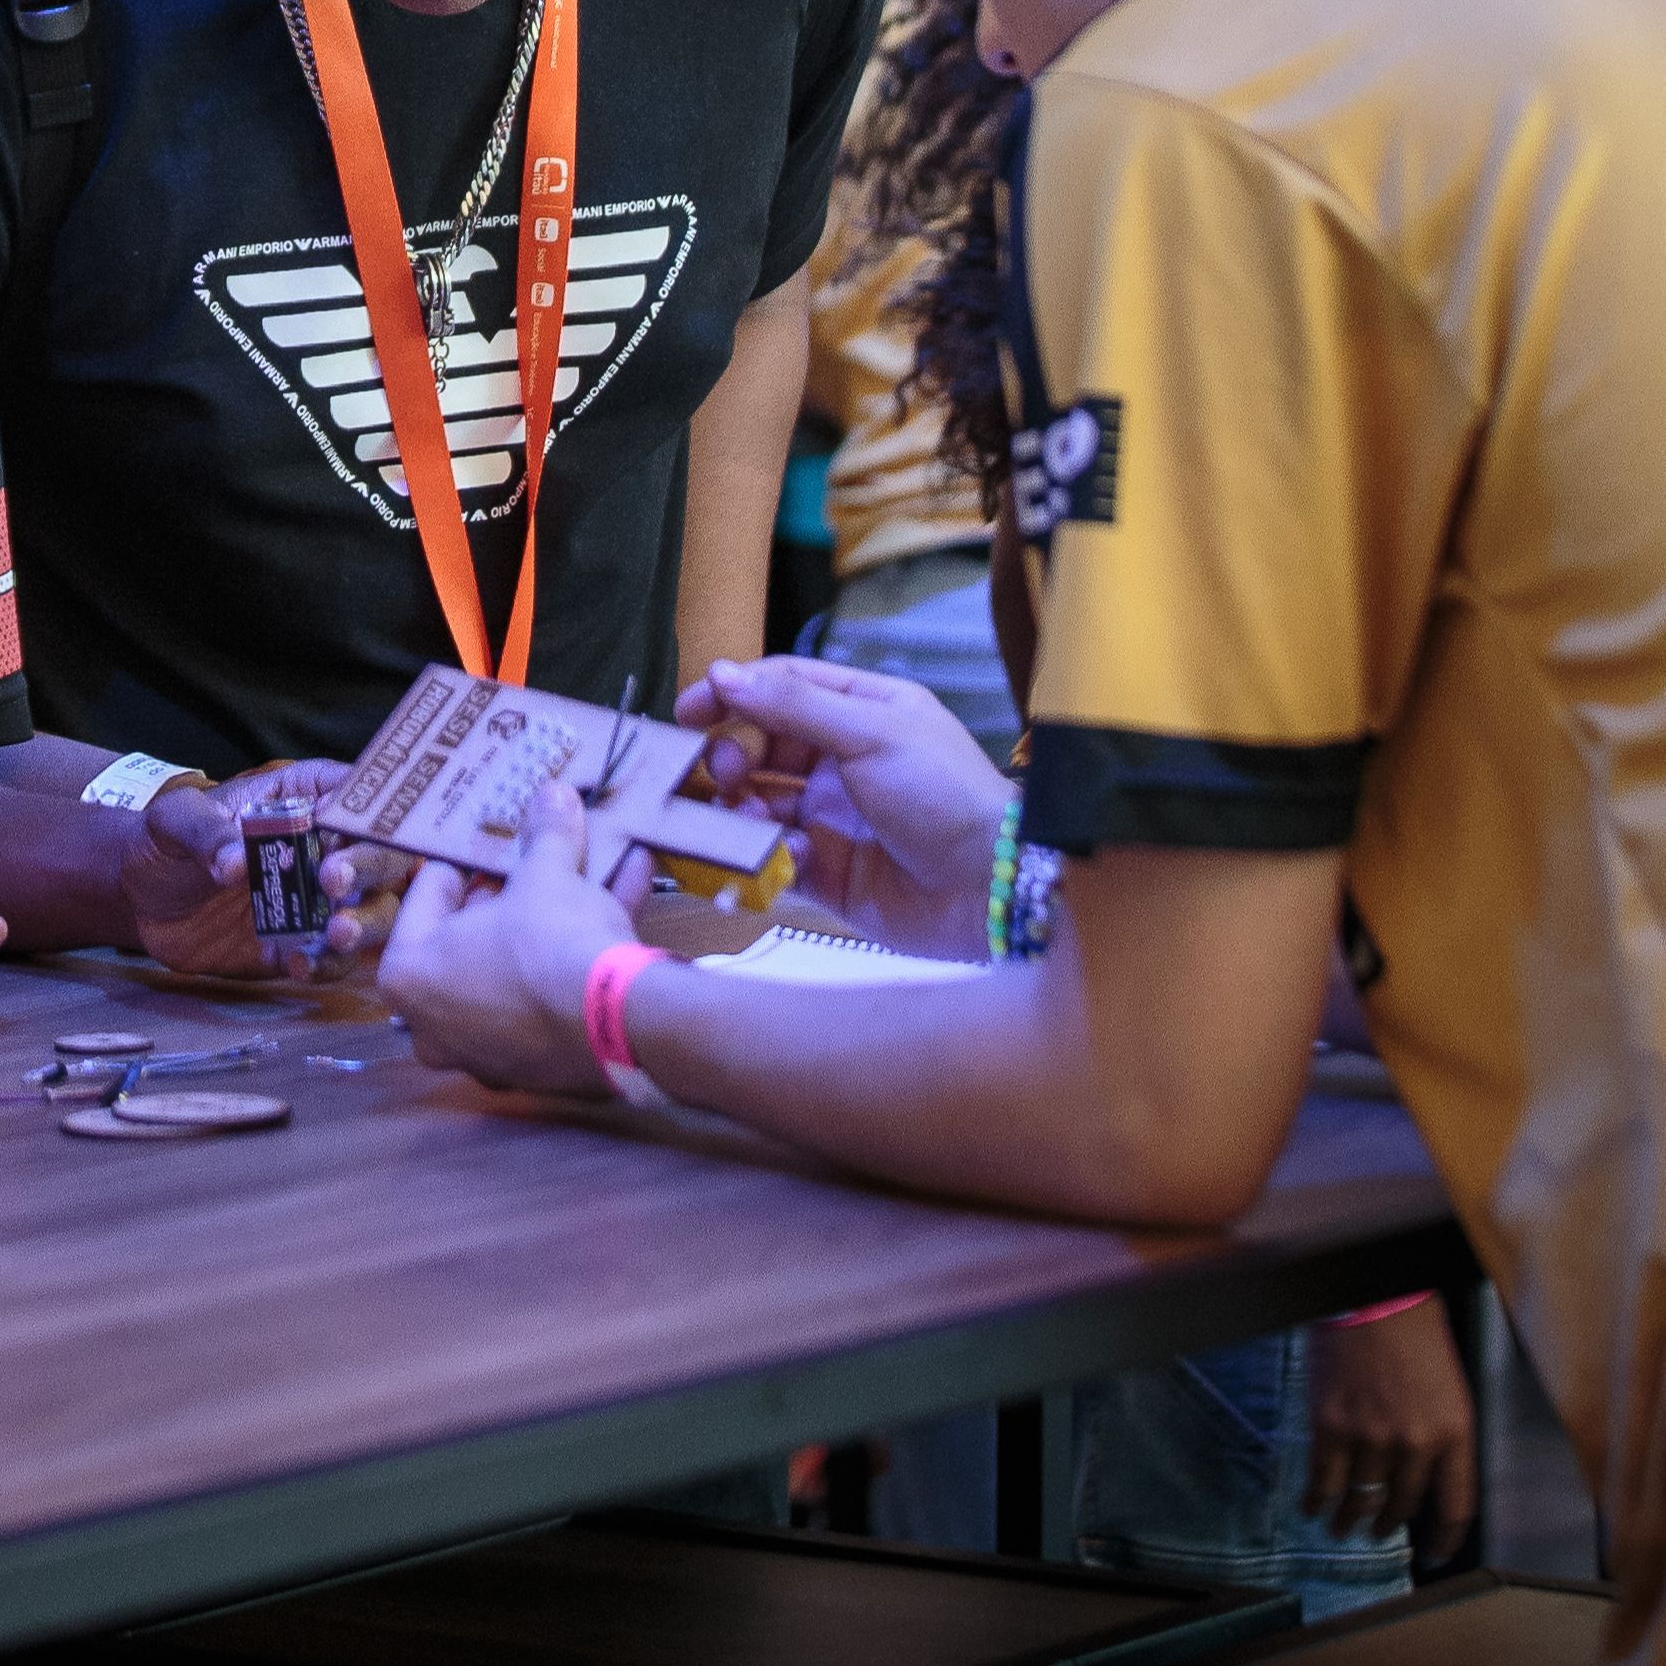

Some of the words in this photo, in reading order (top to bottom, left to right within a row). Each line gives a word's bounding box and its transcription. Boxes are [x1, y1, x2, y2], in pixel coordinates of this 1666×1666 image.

[604, 198, 656, 217] EMPORIO
[671, 194, 698, 243] ARMANI
[192, 247, 237, 285] ARMANI
[238, 240, 294, 258] EMPORIO
[658, 240, 692, 300] EMPORIO
[210, 301, 254, 353] EMPORIO
[615, 315, 652, 366] ARMANI
[248, 347, 291, 391] ARMANI
[573, 362, 619, 416] EMPORIO
[296, 404, 331, 452] EMPORIO
[444, 684, 493, 746] SESI
